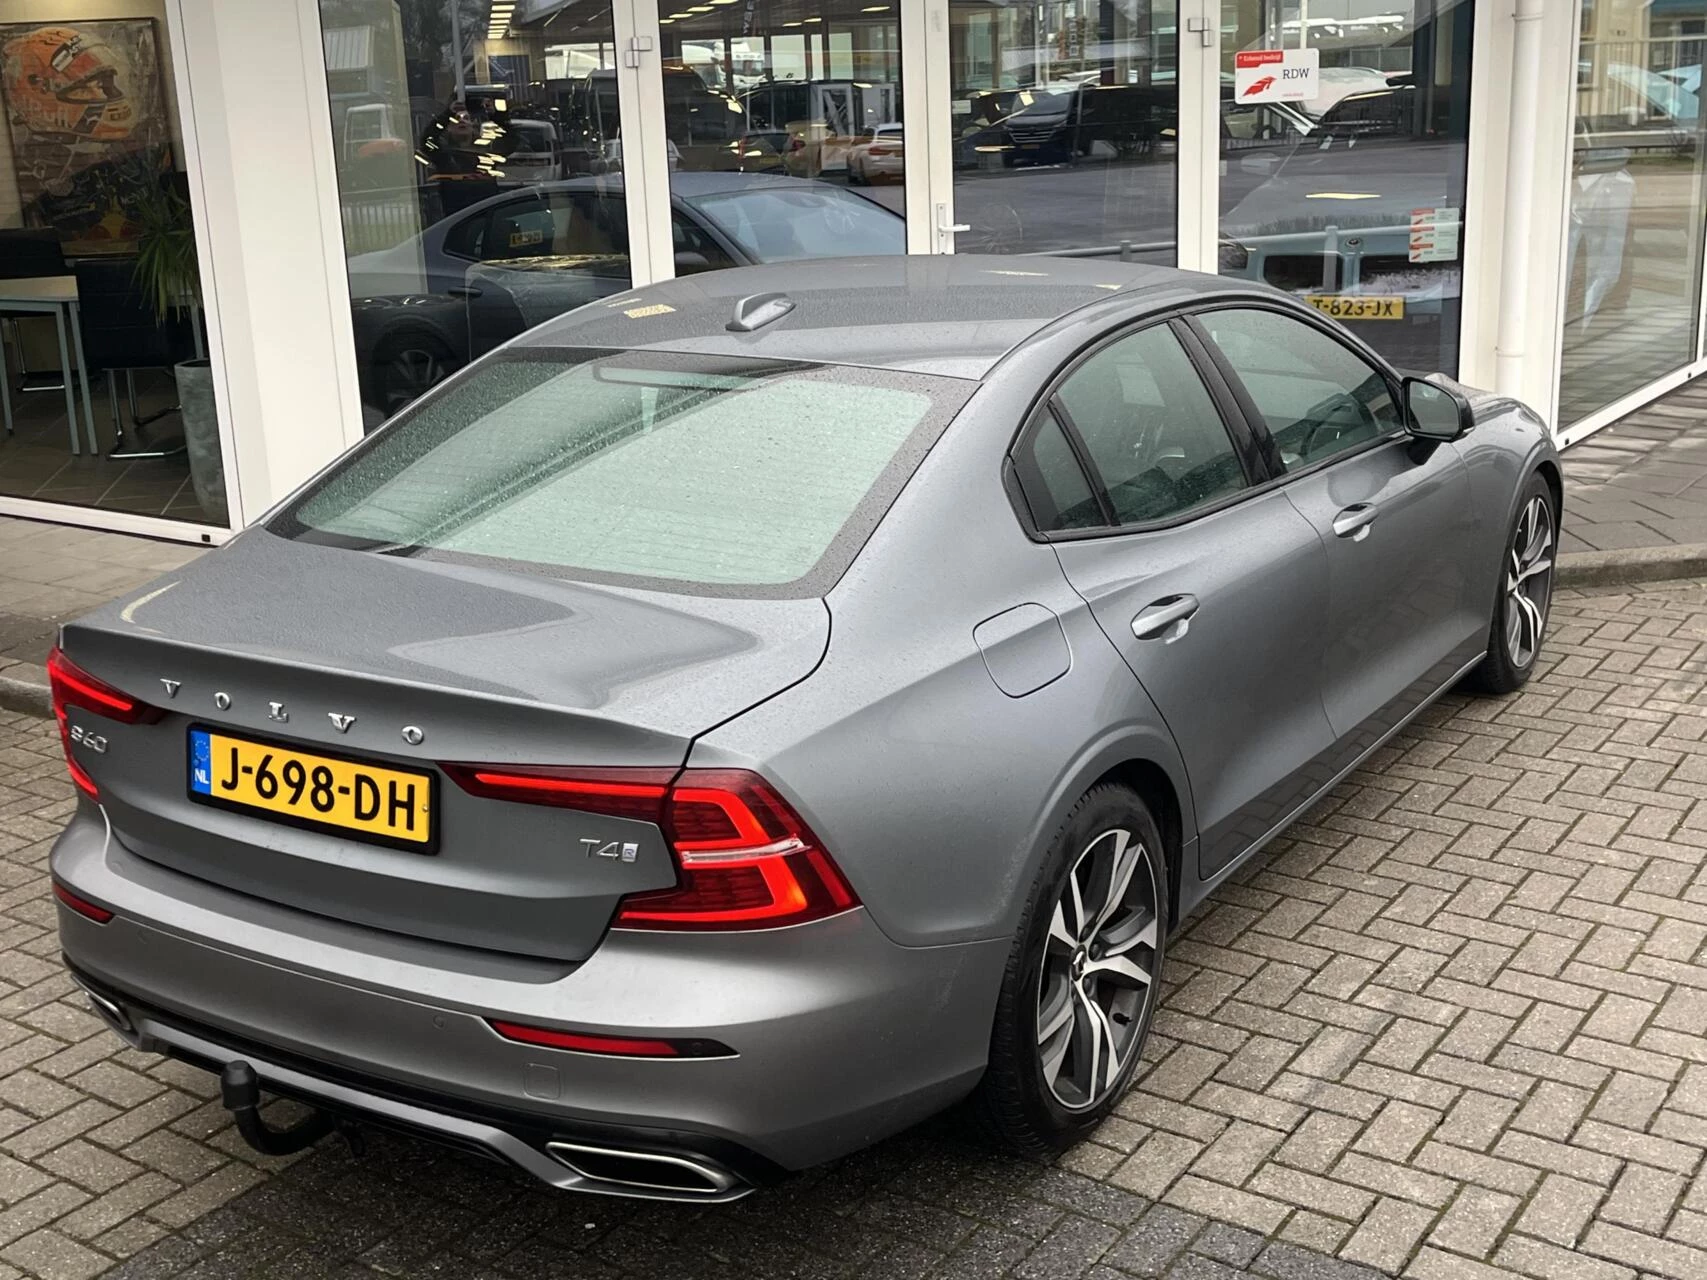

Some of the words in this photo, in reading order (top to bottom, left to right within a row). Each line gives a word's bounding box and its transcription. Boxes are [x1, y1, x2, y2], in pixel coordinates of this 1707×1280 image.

[1283, 68, 1309, 80] RDW
[1313, 299, 1393, 316] T-823-JX
[160, 678, 425, 746] VOLVO
[70, 725, 108, 753] S60
[194, 768, 210, 785] NL
[221, 747, 416, 832] J-698-DH
[580, 838, 619, 861] T4
